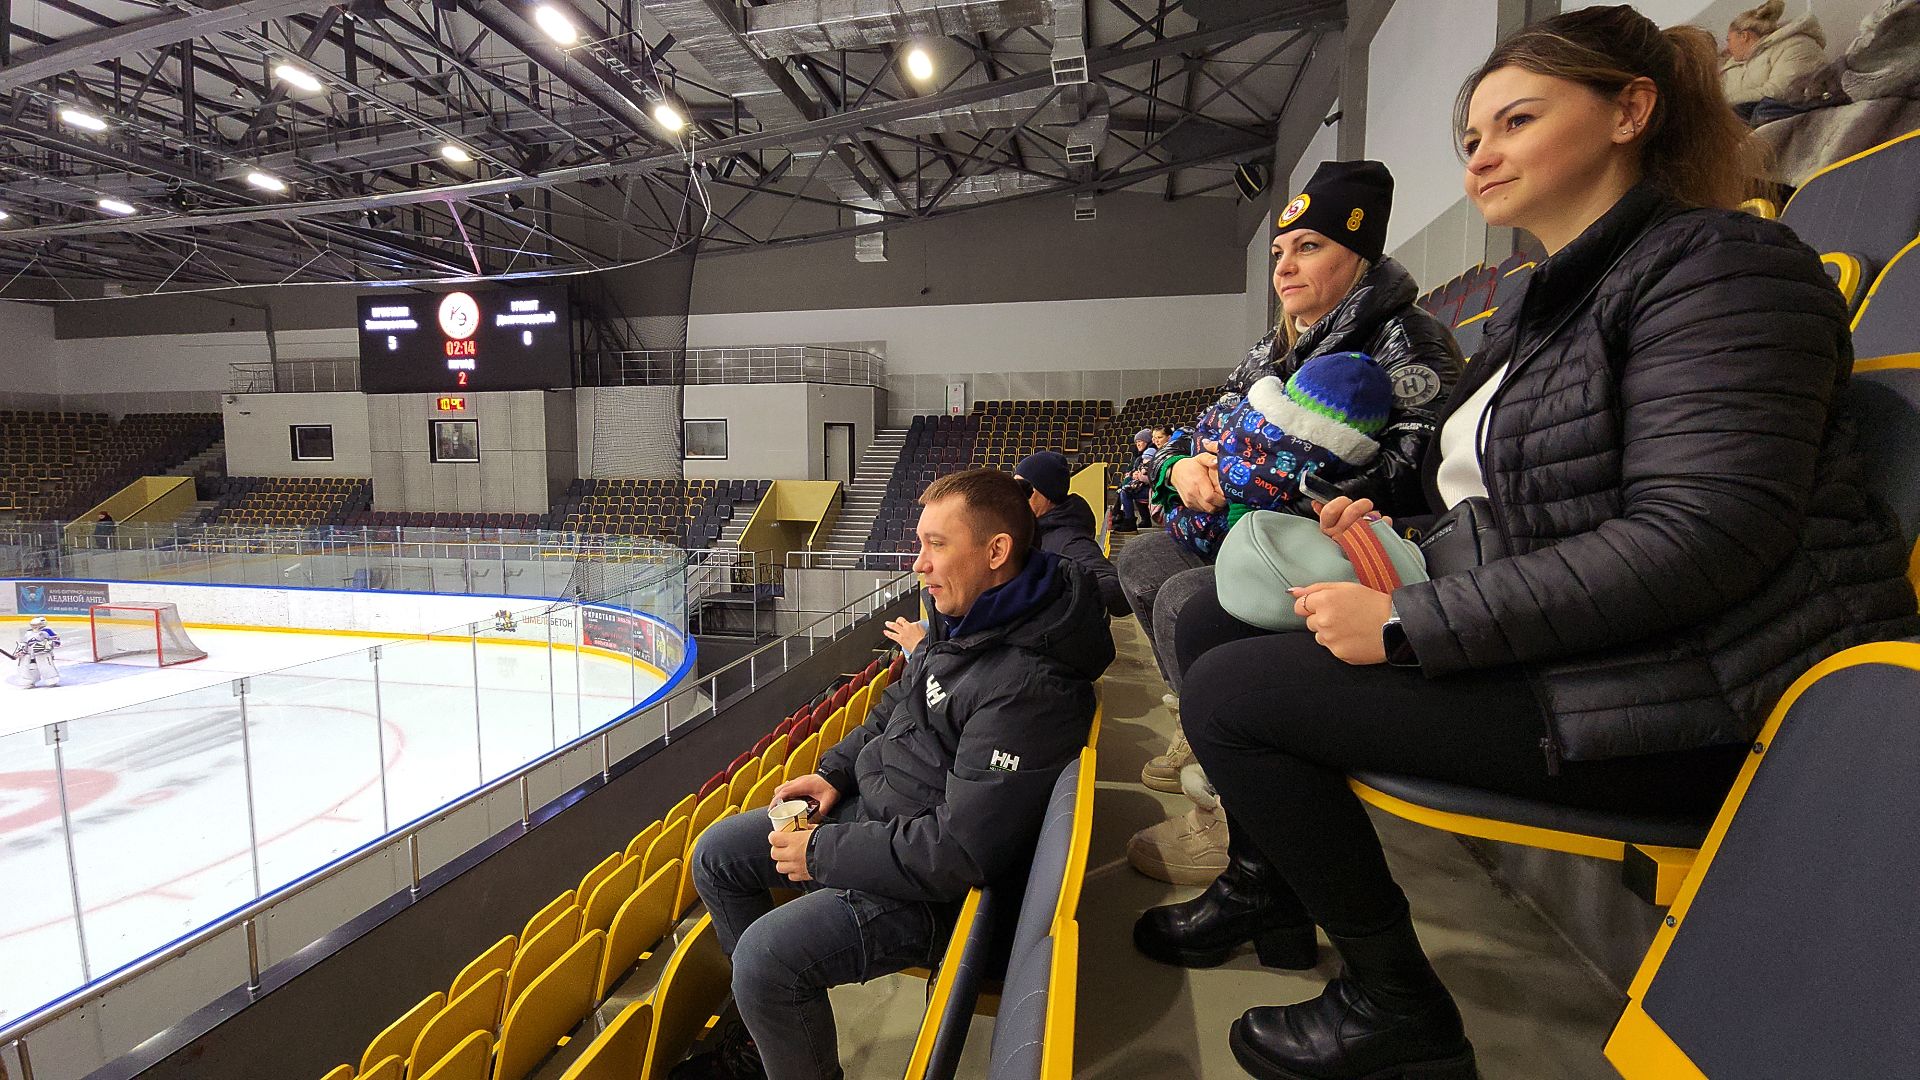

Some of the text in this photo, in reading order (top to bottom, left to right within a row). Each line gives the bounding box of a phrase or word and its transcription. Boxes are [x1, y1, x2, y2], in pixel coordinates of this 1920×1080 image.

[1346, 207, 1364, 232] 8
[446, 341, 476, 356] 02:14
[458, 371, 467, 385] 2
[1402, 377, 1419, 395] H
[1224, 482, 1244, 498] Fred
[1254, 476, 1279, 497] Dave
[48, 595, 84, 604] ЛЕДЯНОЙ
[990, 749, 1020, 772] HH
